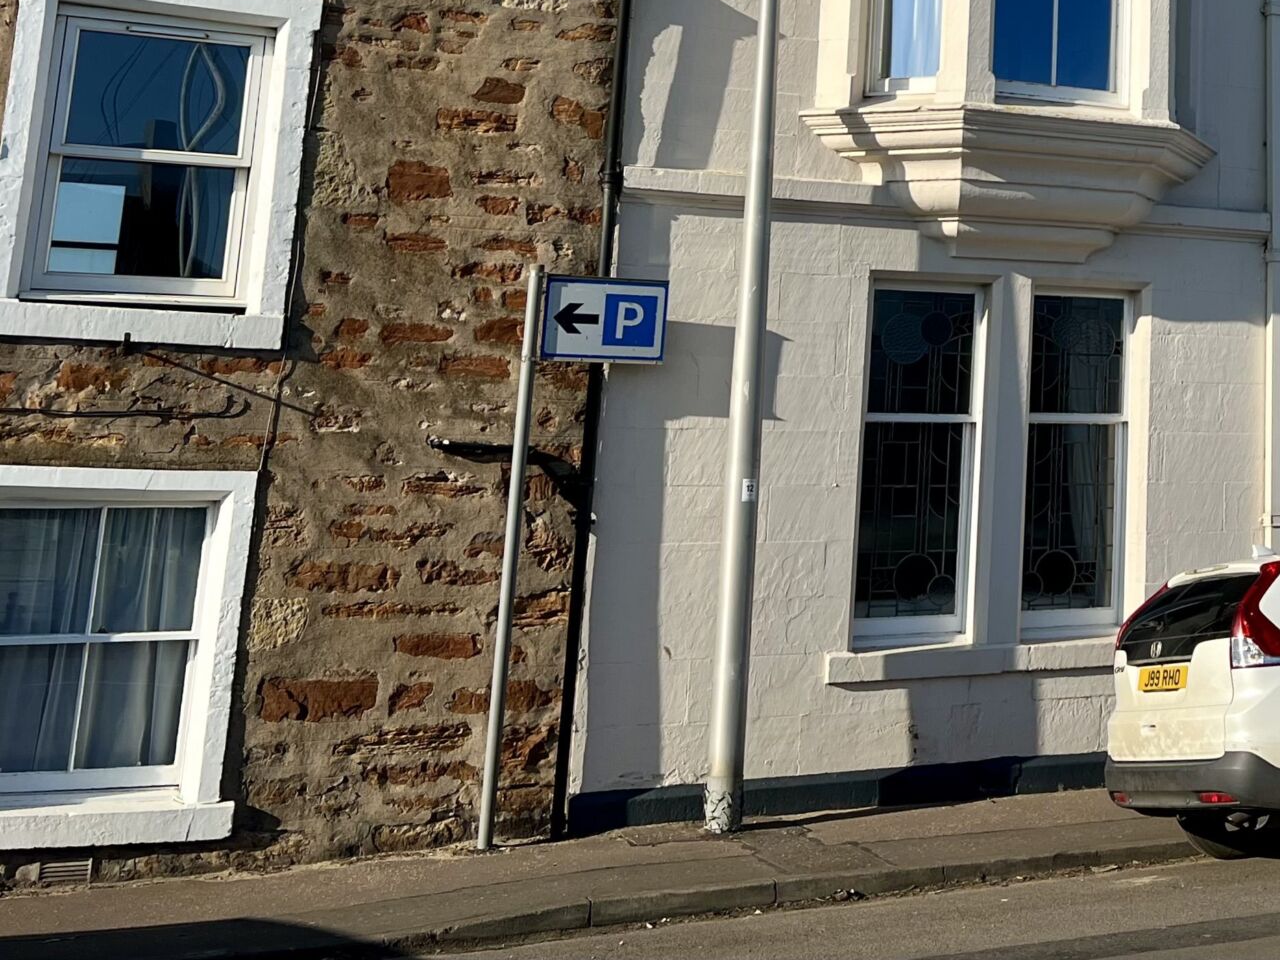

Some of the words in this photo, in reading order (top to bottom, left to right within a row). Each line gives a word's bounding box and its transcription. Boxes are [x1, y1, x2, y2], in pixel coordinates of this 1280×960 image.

[615, 301, 644, 339] P
[746, 483, 755, 493] 12
[1144, 669, 1160, 688] J99
